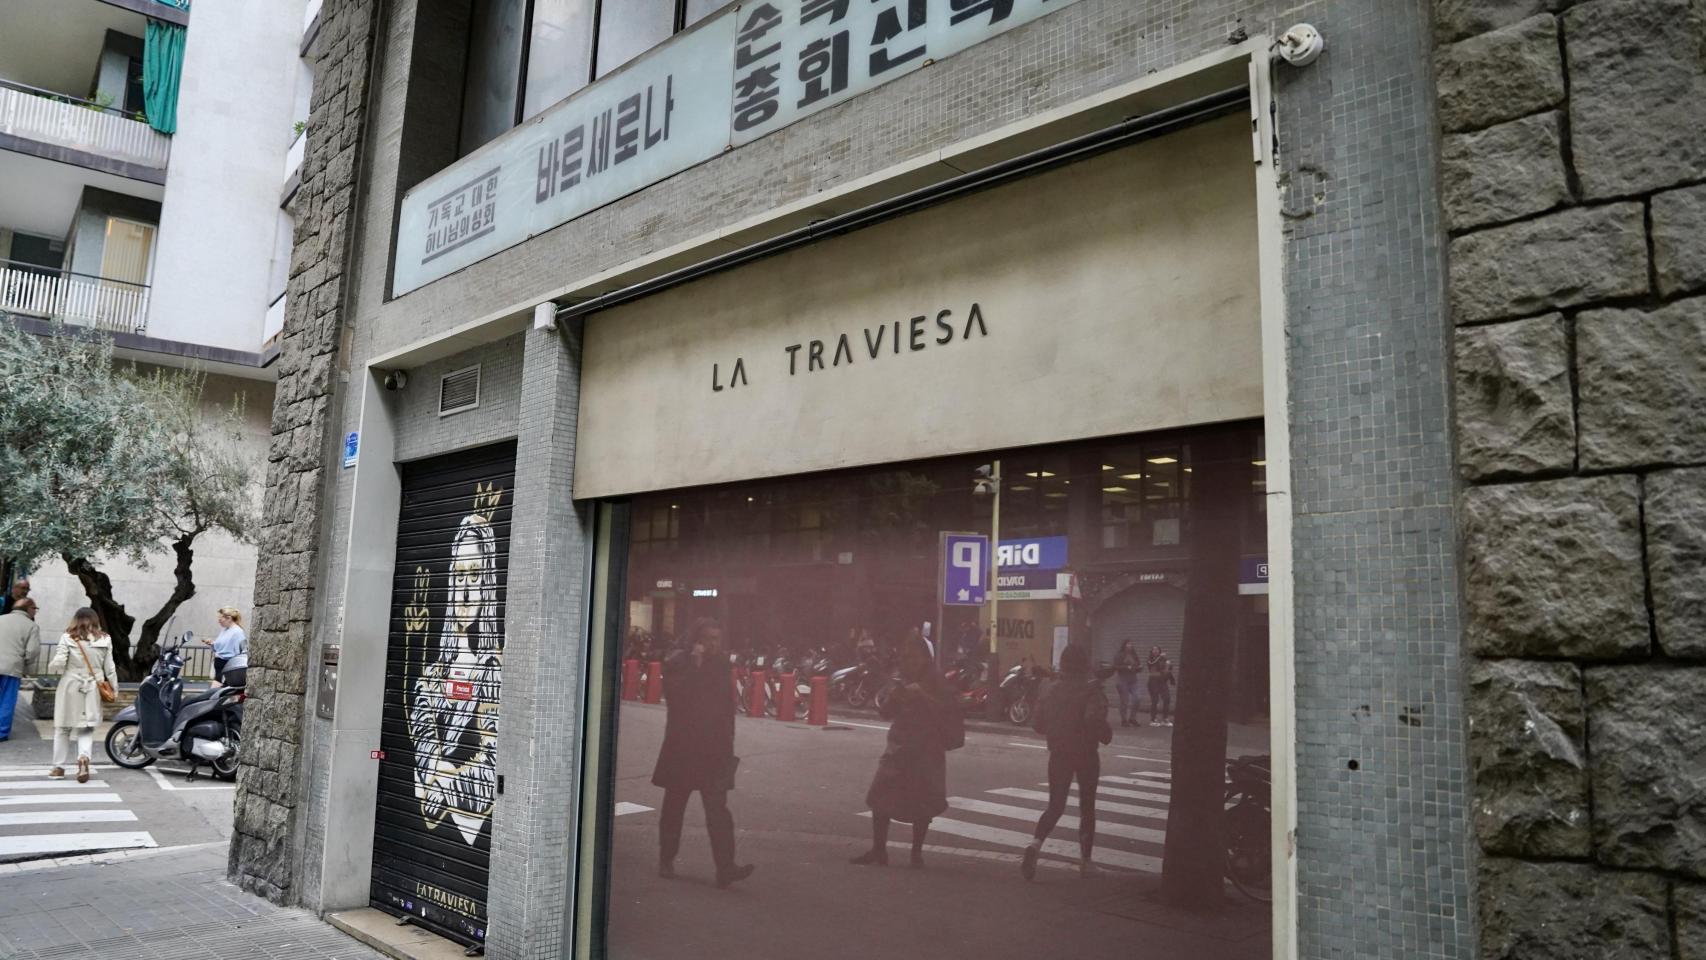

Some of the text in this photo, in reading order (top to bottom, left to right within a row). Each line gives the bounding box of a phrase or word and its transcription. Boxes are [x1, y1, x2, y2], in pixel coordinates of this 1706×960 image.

[535, 73, 675, 205] 바르세로나
[428, 175, 498, 230] 기독교 대한
[712, 302, 988, 392] LA TRAVIESA
